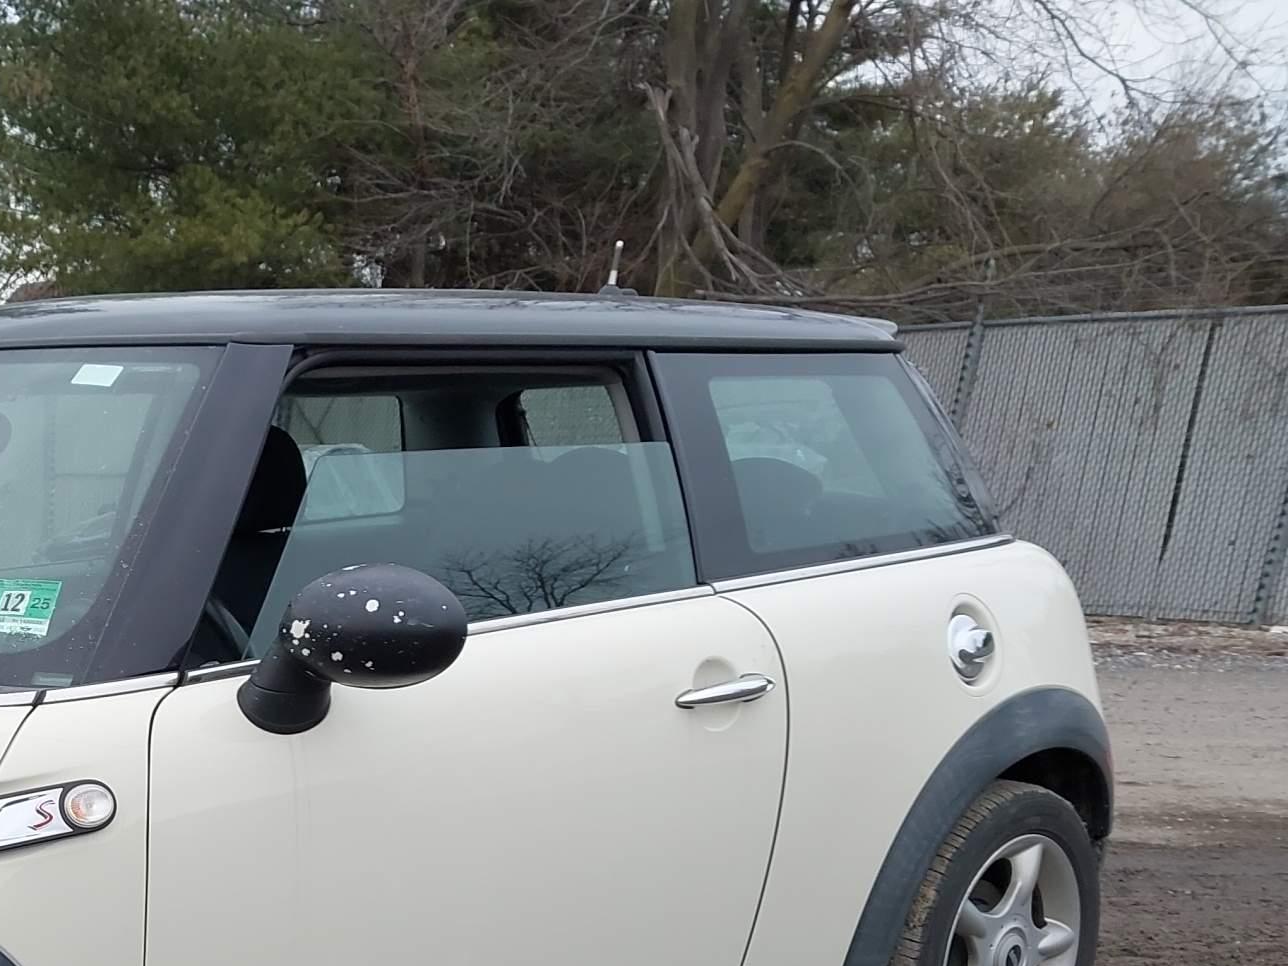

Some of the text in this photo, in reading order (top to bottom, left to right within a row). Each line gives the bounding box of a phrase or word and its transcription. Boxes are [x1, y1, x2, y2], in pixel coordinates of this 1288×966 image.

[1, 592, 25, 611] 12
[30, 598, 51, 609] 25
[27, 799, 56, 831] S
